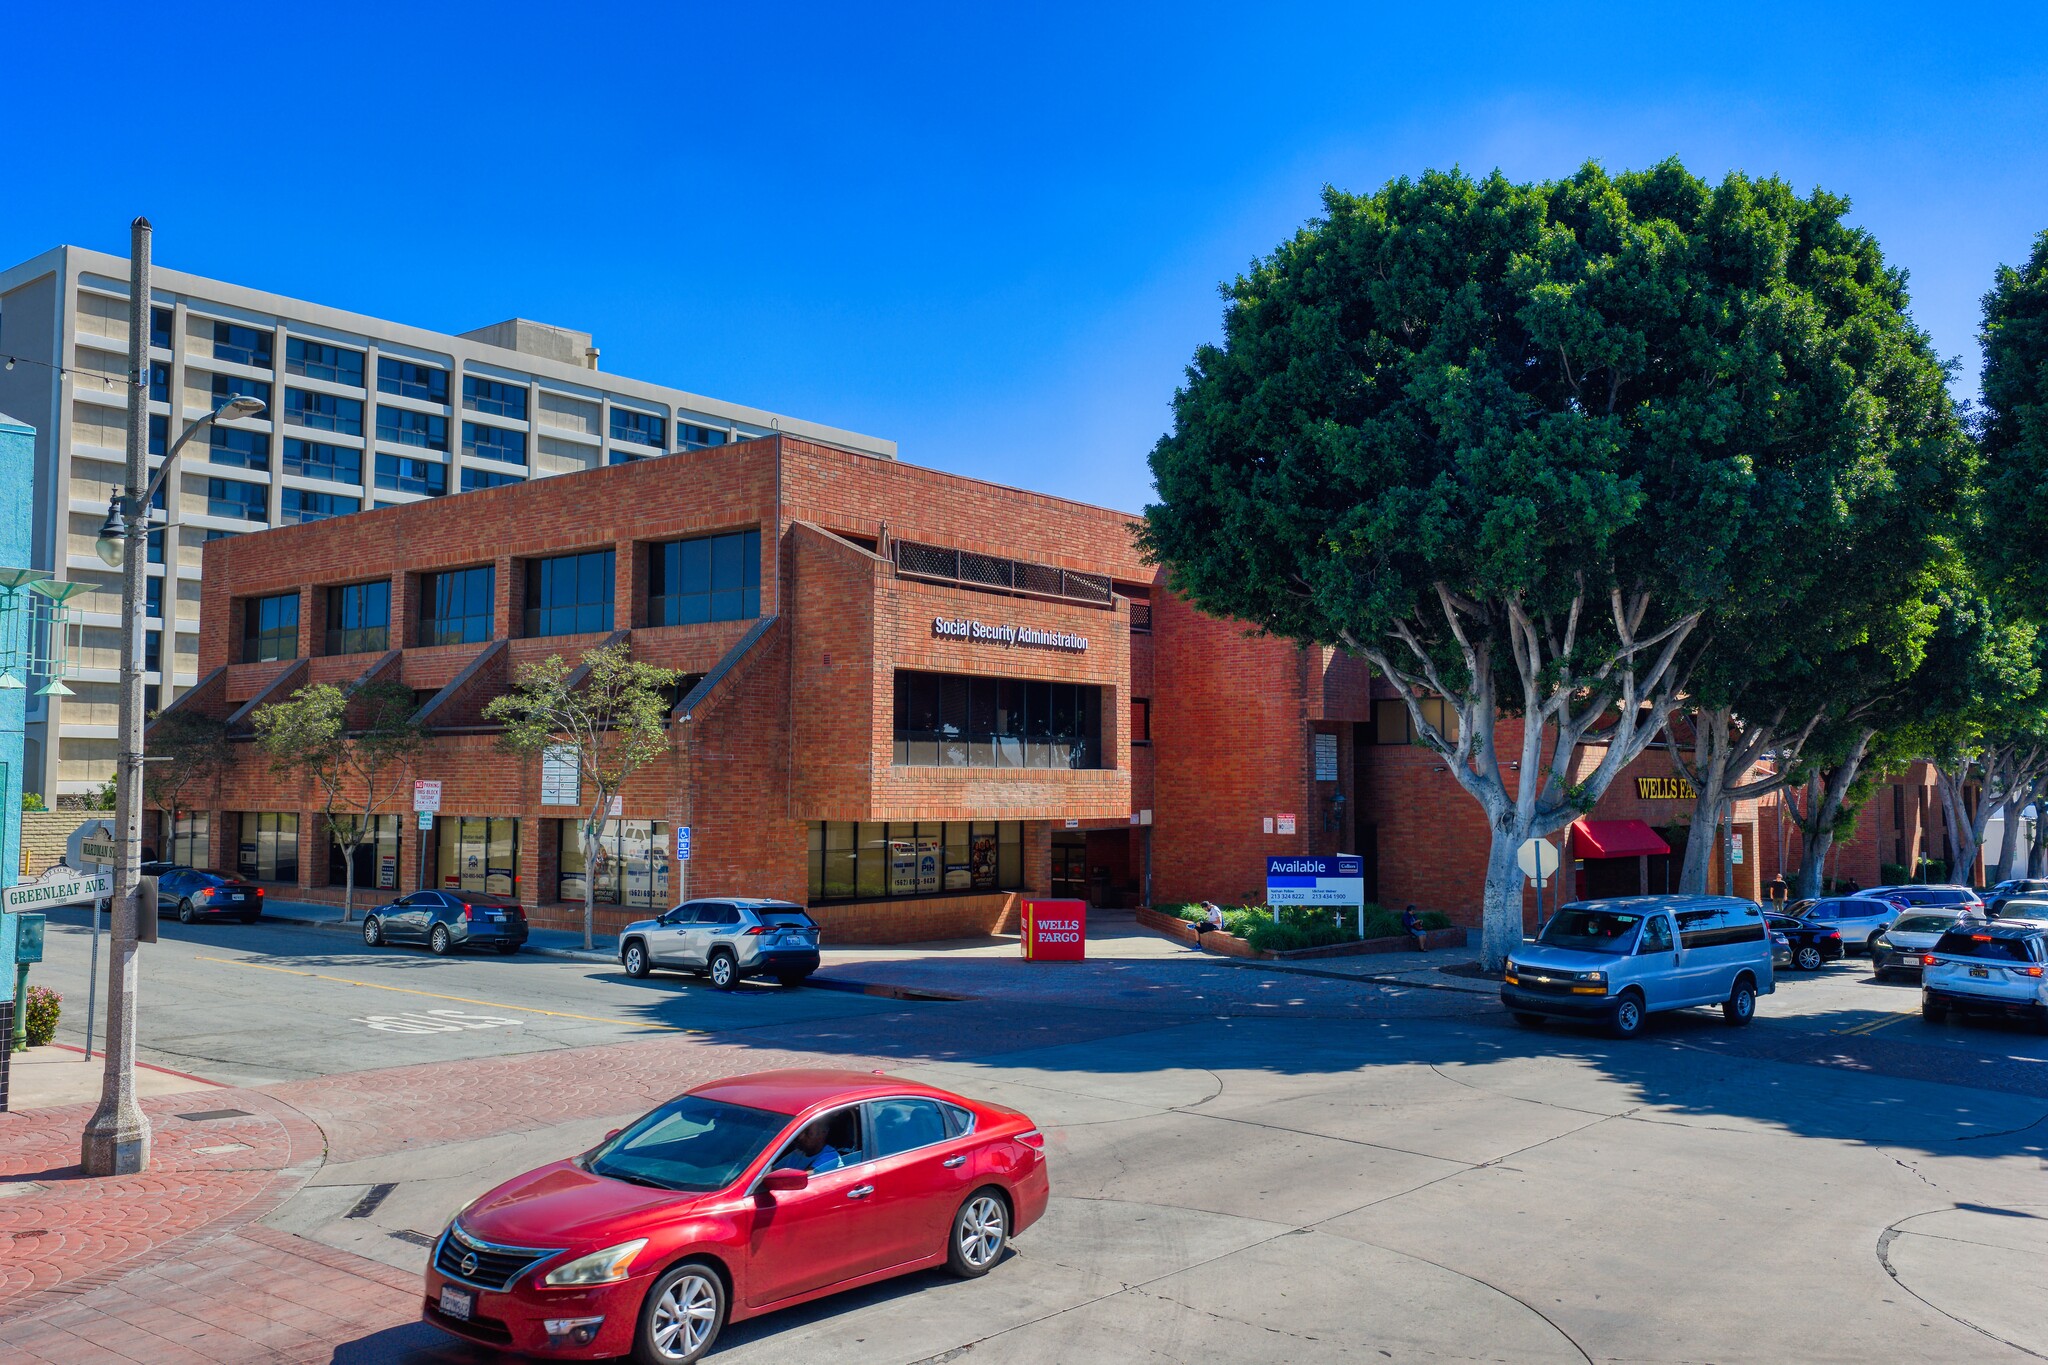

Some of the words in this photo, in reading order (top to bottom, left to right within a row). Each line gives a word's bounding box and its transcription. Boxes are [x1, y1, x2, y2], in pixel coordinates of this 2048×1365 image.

[935, 616, 970, 636] Social
[972, 621, 1016, 645] Security
[1017, 626, 1089, 649] Administration
[1638, 777, 1678, 799] WELLS
[1679, 778, 1697, 799] FA
[921, 863, 935, 872] PIH
[1270, 860, 1326, 873] Available
[10, 882, 81, 905] GREENLEAF
[85, 878, 109, 894] AVE.
[643, 889, 669, 898] 693-94
[1037, 920, 1079, 930] WELLS
[1038, 932, 1080, 943] FARGO
